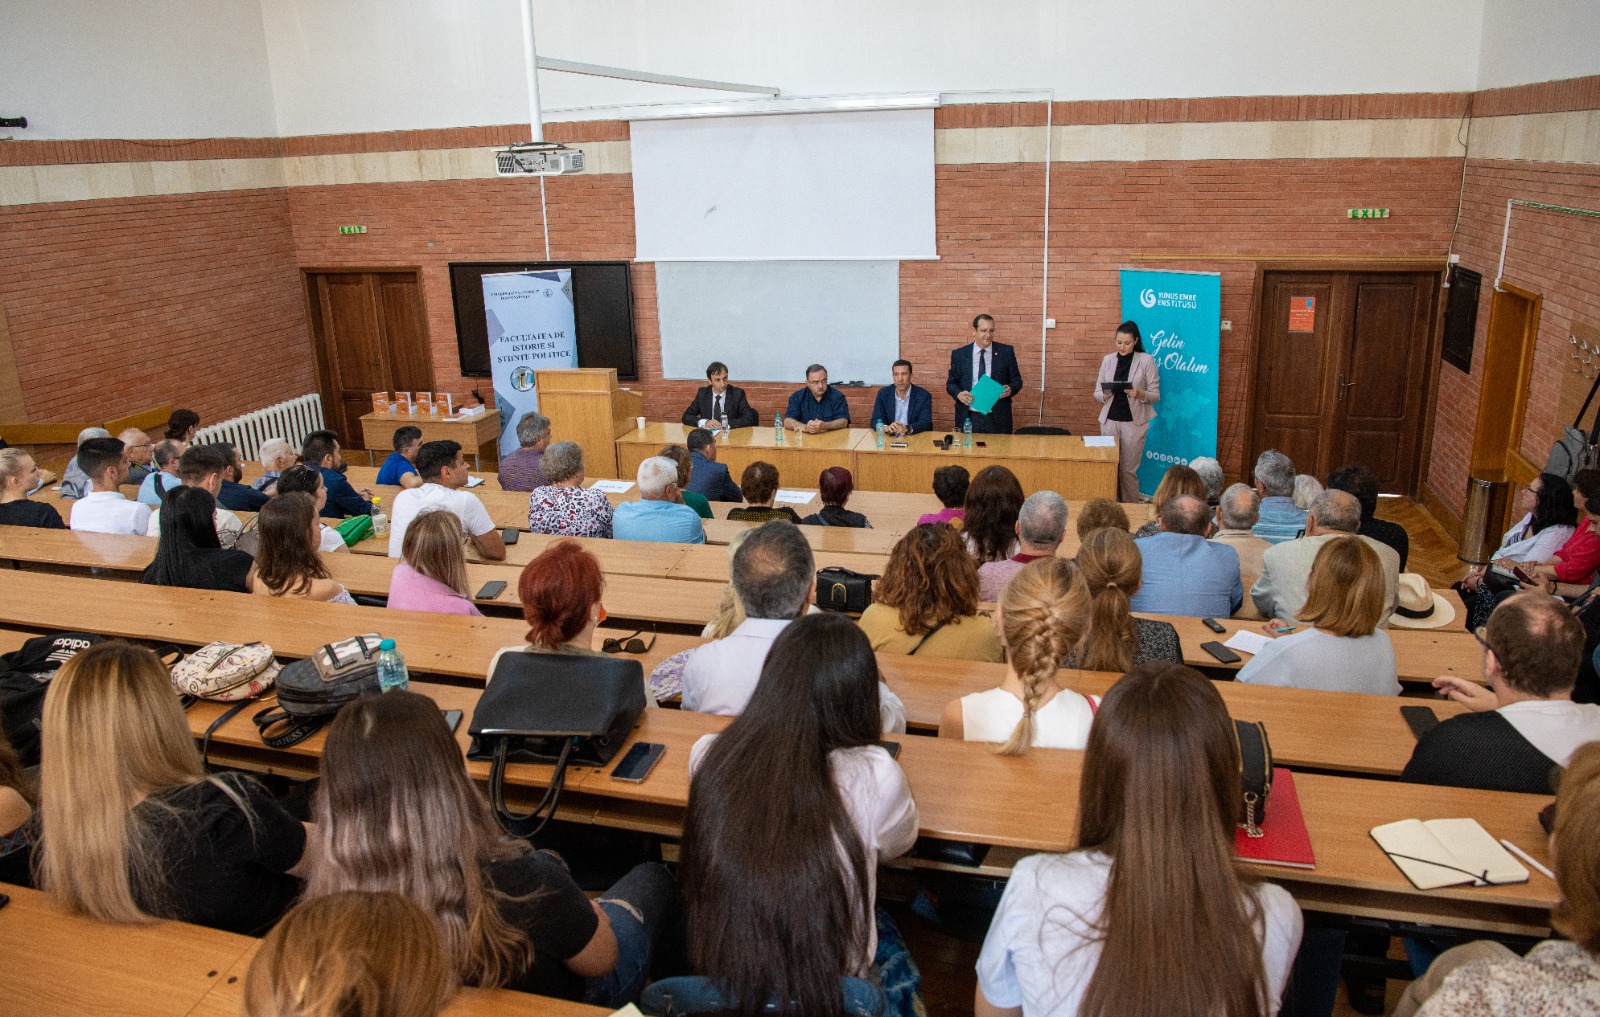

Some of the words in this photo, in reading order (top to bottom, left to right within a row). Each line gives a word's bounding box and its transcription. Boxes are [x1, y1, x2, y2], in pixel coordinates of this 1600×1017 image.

[1351, 208, 1386, 218] EXIT
[340, 225, 362, 234] EXIT
[1158, 292, 1179, 300] YUNUS
[500, 332, 553, 343] FACULTATEA
[554, 331, 566, 339] DE
[512, 342, 546, 352] ISTORIE
[1150, 330, 1186, 357] Gelin
[532, 350, 571, 360] POLITICE
[1164, 352, 1210, 374] Olalım
[52, 637, 91, 650] adidas
[272, 729, 303, 746] GUESS
